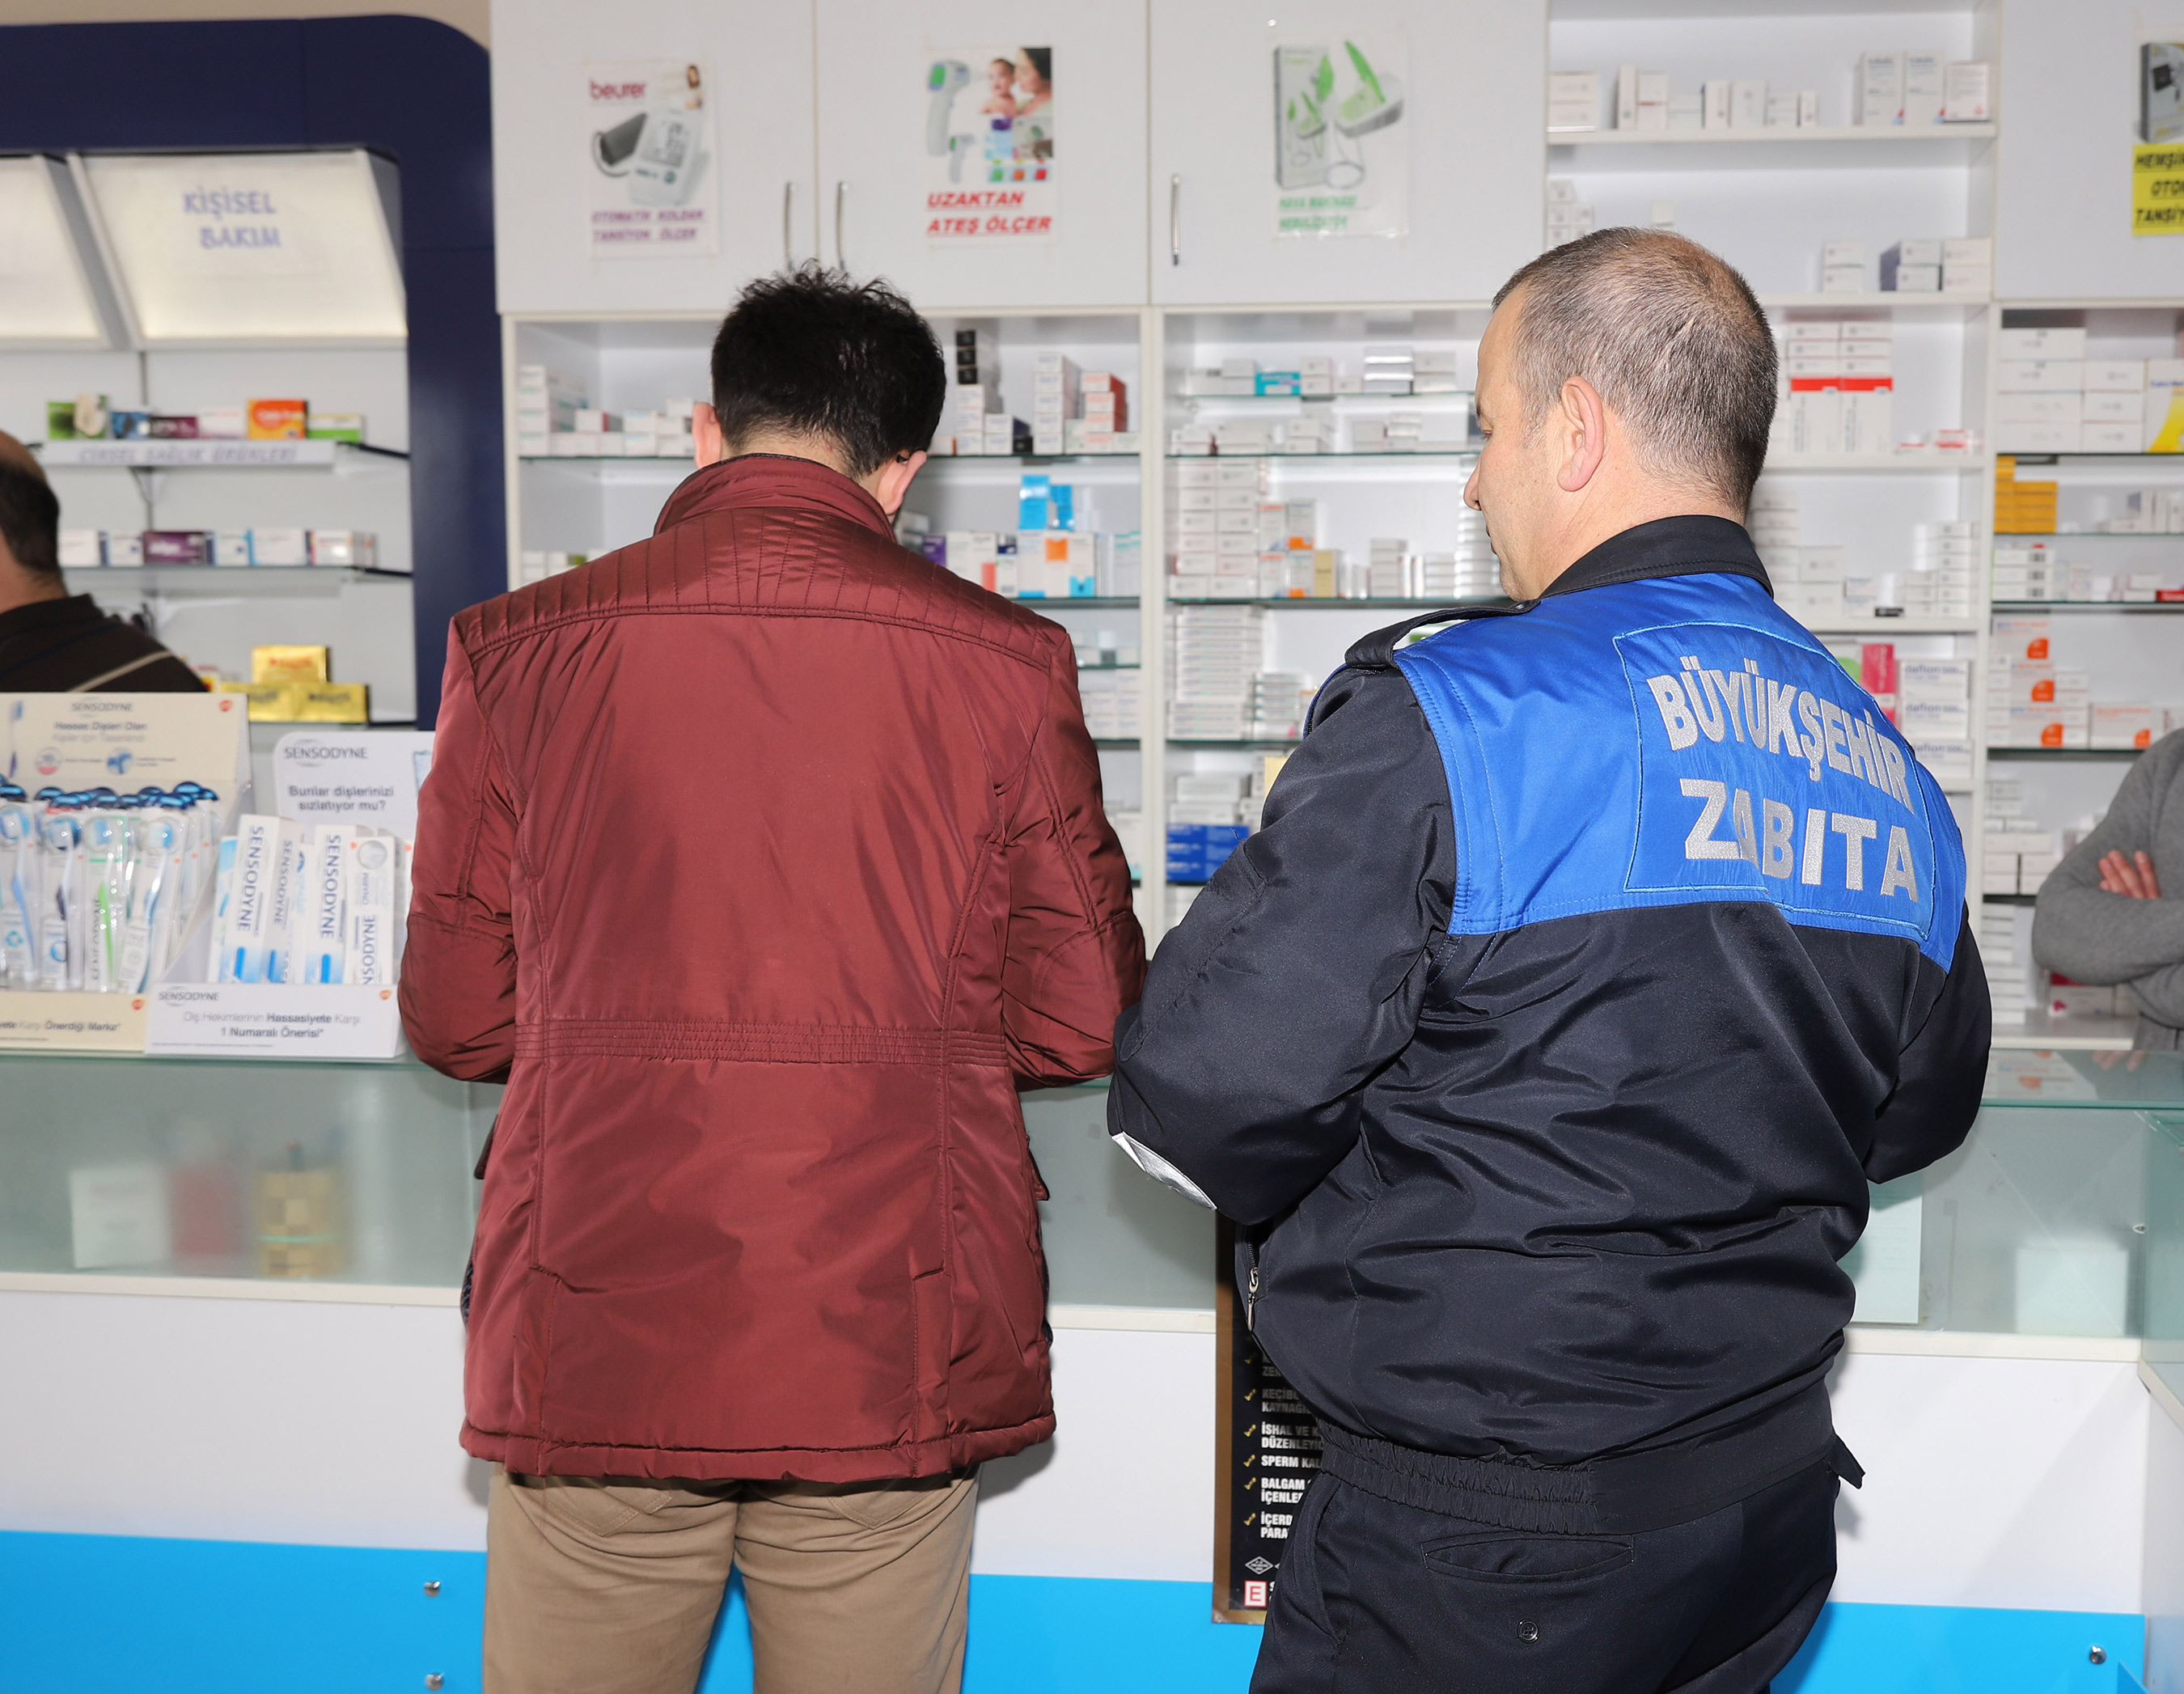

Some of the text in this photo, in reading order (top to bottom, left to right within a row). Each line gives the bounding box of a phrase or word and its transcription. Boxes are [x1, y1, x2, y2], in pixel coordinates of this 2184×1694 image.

[590, 79, 645, 100] beurer
[928, 192, 1024, 207] UZAKTAN
[928, 214, 1052, 235] ATEŞ ÖLÇER
[200, 227, 281, 248] BAKIM
[1647, 655, 1914, 814] BÜYÜKŞEHİR
[285, 747, 368, 759] SENSODYNE
[289, 786, 394, 799] Bunlar dişlerinizi
[298, 800, 386, 812] sızlatıyor mu?
[1679, 778, 1919, 903] ZABITA
[239, 825, 265, 932] SENSODYNE
[274, 840, 293, 925] SENSODYNE
[321, 834, 342, 938] SENSODYNE
[159, 992, 219, 1002] SENSODYNE
[267, 1012, 332, 1024] Hassasiyete
[231, 1027, 278, 1037] Numaralı
[1262, 1421, 1293, 1435] İSHAL
[1296, 1425, 1309, 1435] VE
[1261, 1455, 1298, 1467] SPERM
[1261, 1477, 1305, 1490] BALGAM
